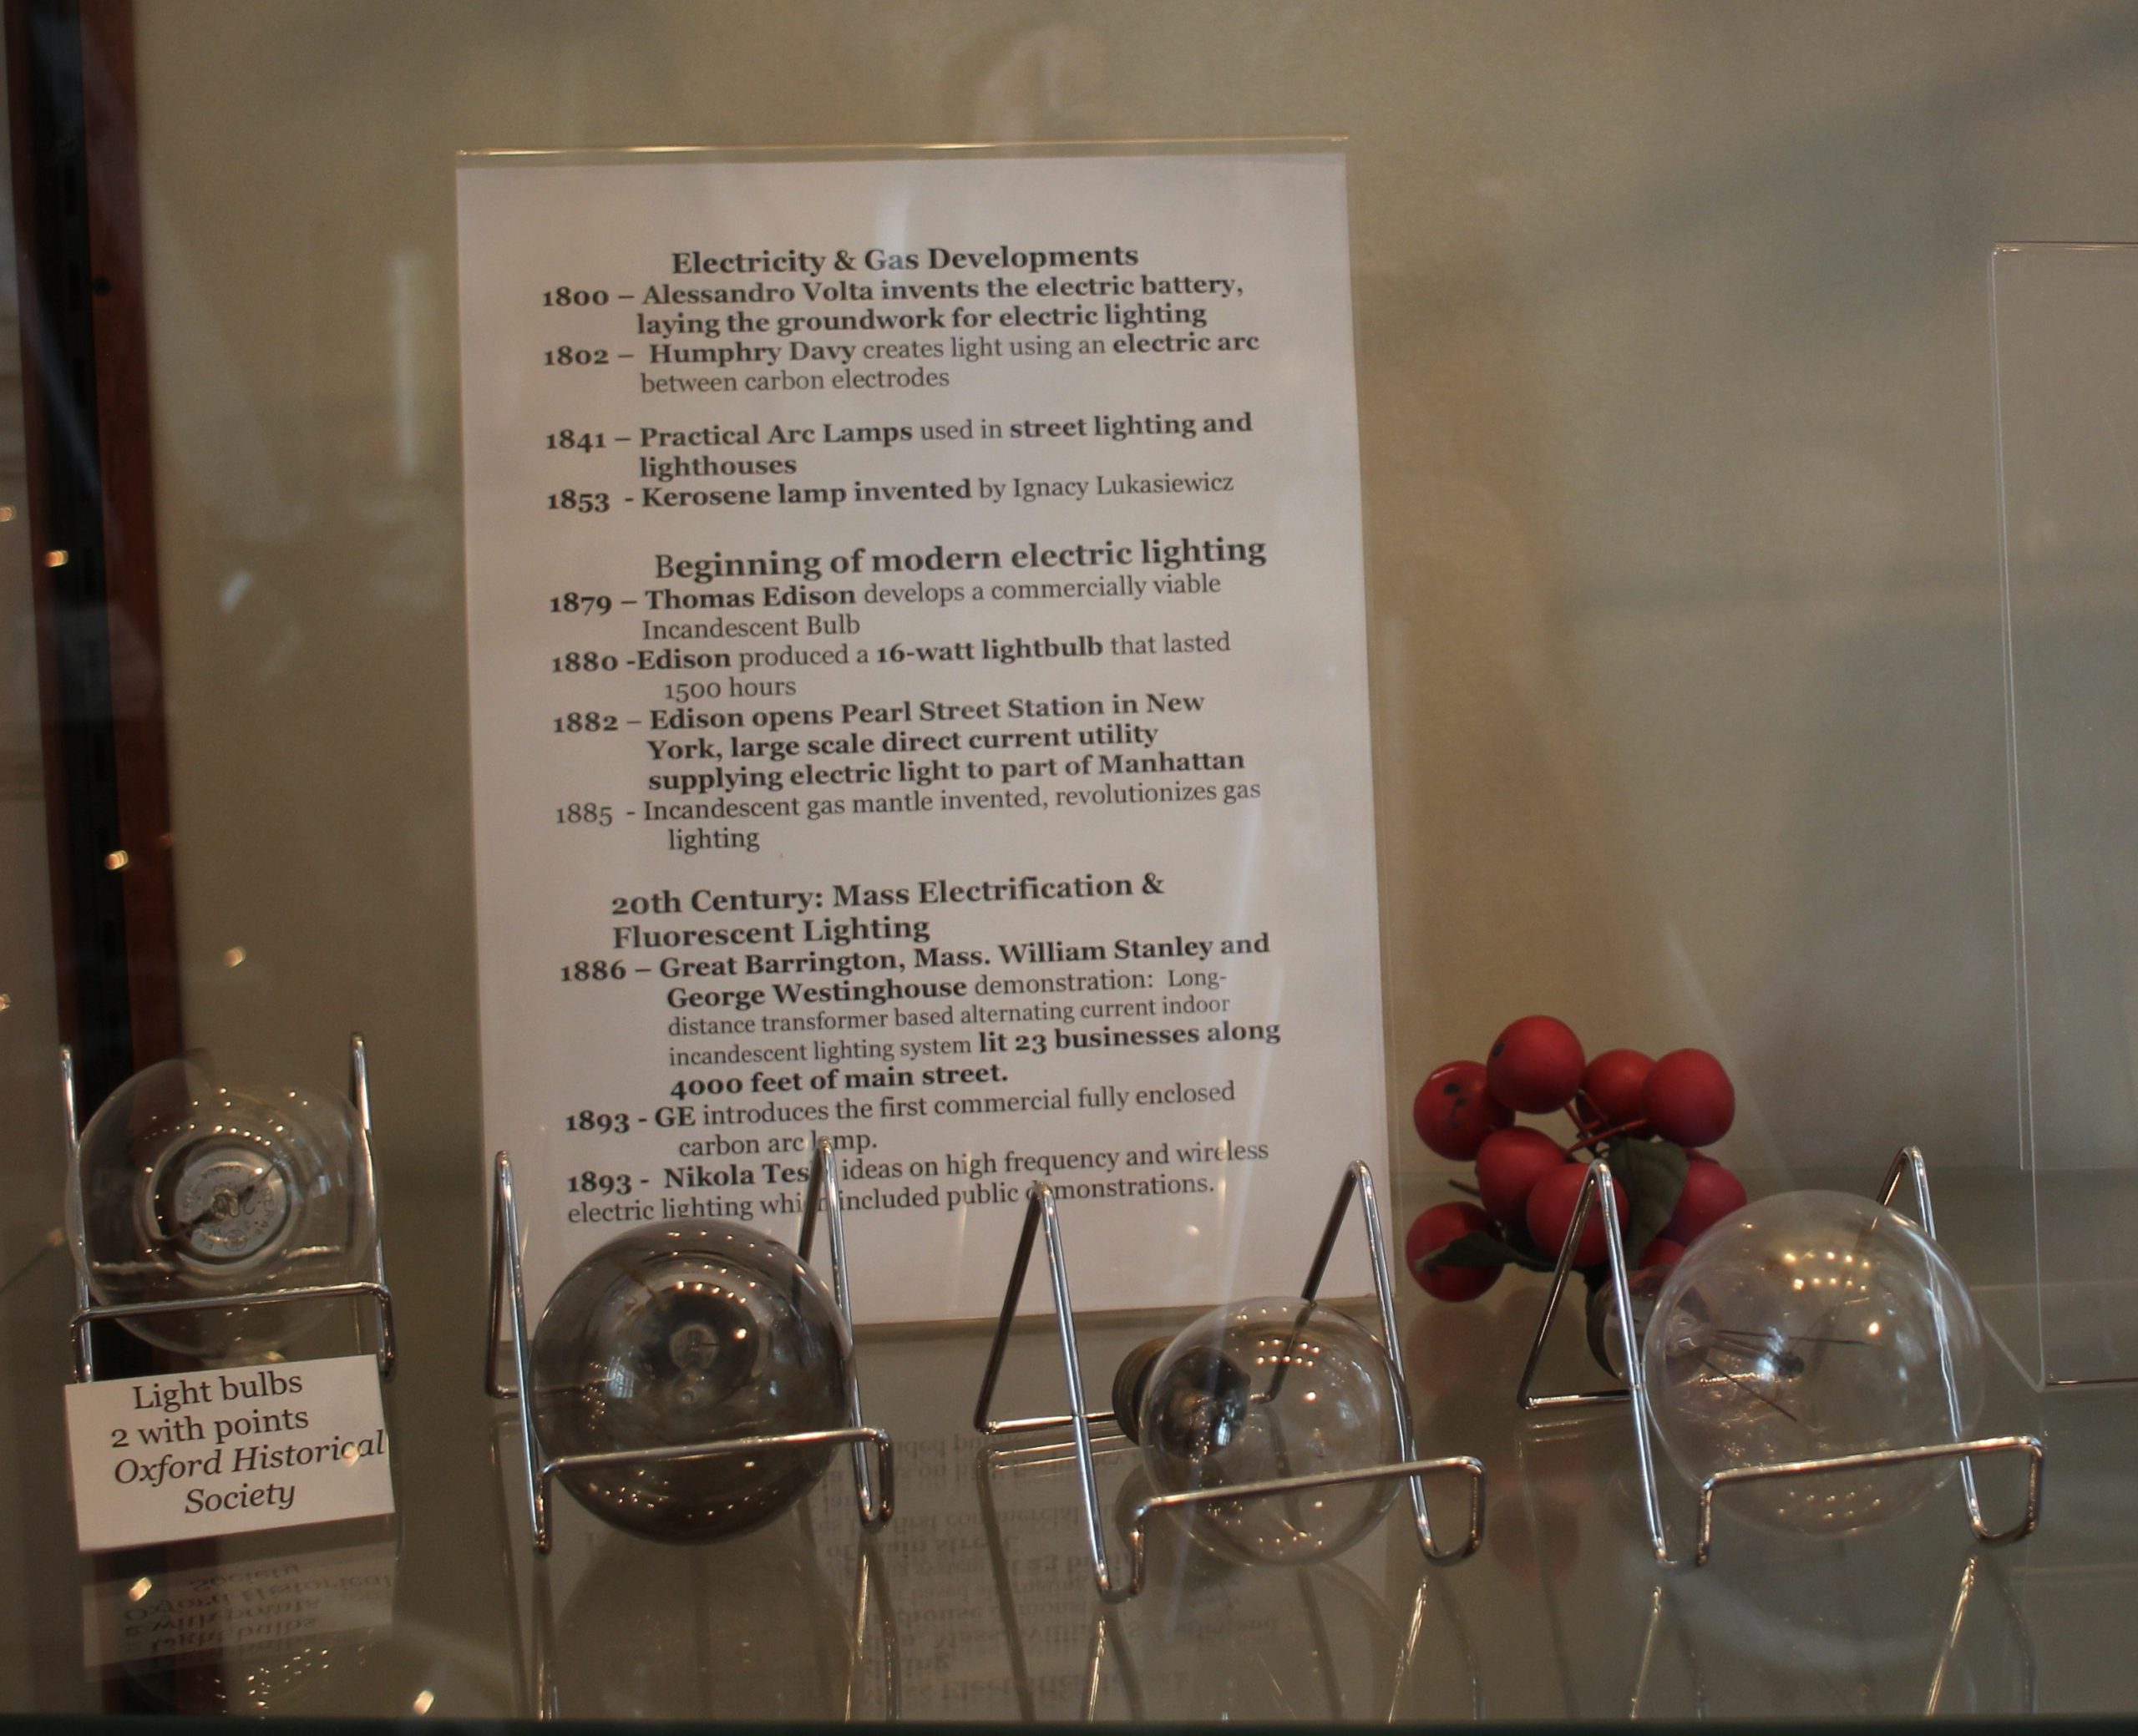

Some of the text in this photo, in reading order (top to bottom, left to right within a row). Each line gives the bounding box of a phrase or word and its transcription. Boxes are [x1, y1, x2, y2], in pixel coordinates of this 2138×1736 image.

[671, 245, 1139, 278] Electricity & Gas Developments
[543, 273, 1243, 307] 1800 Alessandro Volta invents the electric battery,
[636, 301, 1208, 340] laying the groundwork for electric lighting
[545, 331, 1259, 368] 1802 Humphry Davy creates light using electric arc
[640, 365, 950, 394] between carbon electrodes
[546, 411, 1253, 454] 1841 Practical Arc Lamps used street lighting and
[639, 454, 798, 483] lighthouses
[548, 471, 1234, 514] 1853 Kerosene lamp invented Ignacy Lukasiewicz
[655, 536, 1267, 585] Beginning modern electric lighting
[550, 571, 1221, 617] 1879 Thomas Edison develops commercially viable
[642, 612, 860, 640] Incandescent Bulb
[552, 630, 1231, 674] 1880 produced 16-watt lightbulb that lasted
[666, 676, 797, 704] 1500 hours
[554, 692, 1204, 734] 1882 Edison opens Pearl Street Station New
[646, 722, 1158, 762] York, large scale direct current utility
[648, 750, 1244, 796] supplying electric light part Manhattan
[556, 780, 1261, 828] 1885 Incandescent gas mantle invented, revolutionizes gas
[668, 827, 760, 856] lighting
[611, 872, 1164, 916] 20th Century: Mass Electrification &
[613, 914, 930, 949] Fluorescent Lighting
[561, 931, 1270, 983] 1886 Great Barrington, Mass. William Stanley and
[666, 968, 1227, 1012] George Westinghouse demonstration: Long-
[667, 994, 1230, 1037] distance transformer based alternating current indoor
[669, 1020, 1281, 1067] incandescent lighting system lit 23 businesses along
[670, 1063, 1008, 1101] 4000 feet main street.
[566, 1078, 1235, 1135] 1893 GE introduces first commercial fully enclosed
[678, 1132, 804, 1158] carbon arc
[568, 1143, 1169, 1197] 1893 Nikola ideas frequency and
[568, 1182, 1019, 1223] electric included public
[132, 1369, 303, 1414] Light bulbs
[111, 1408, 309, 1449] 2 with points
[114, 1428, 385, 1489] Oxford Historical
[185, 1482, 296, 1515] Society
